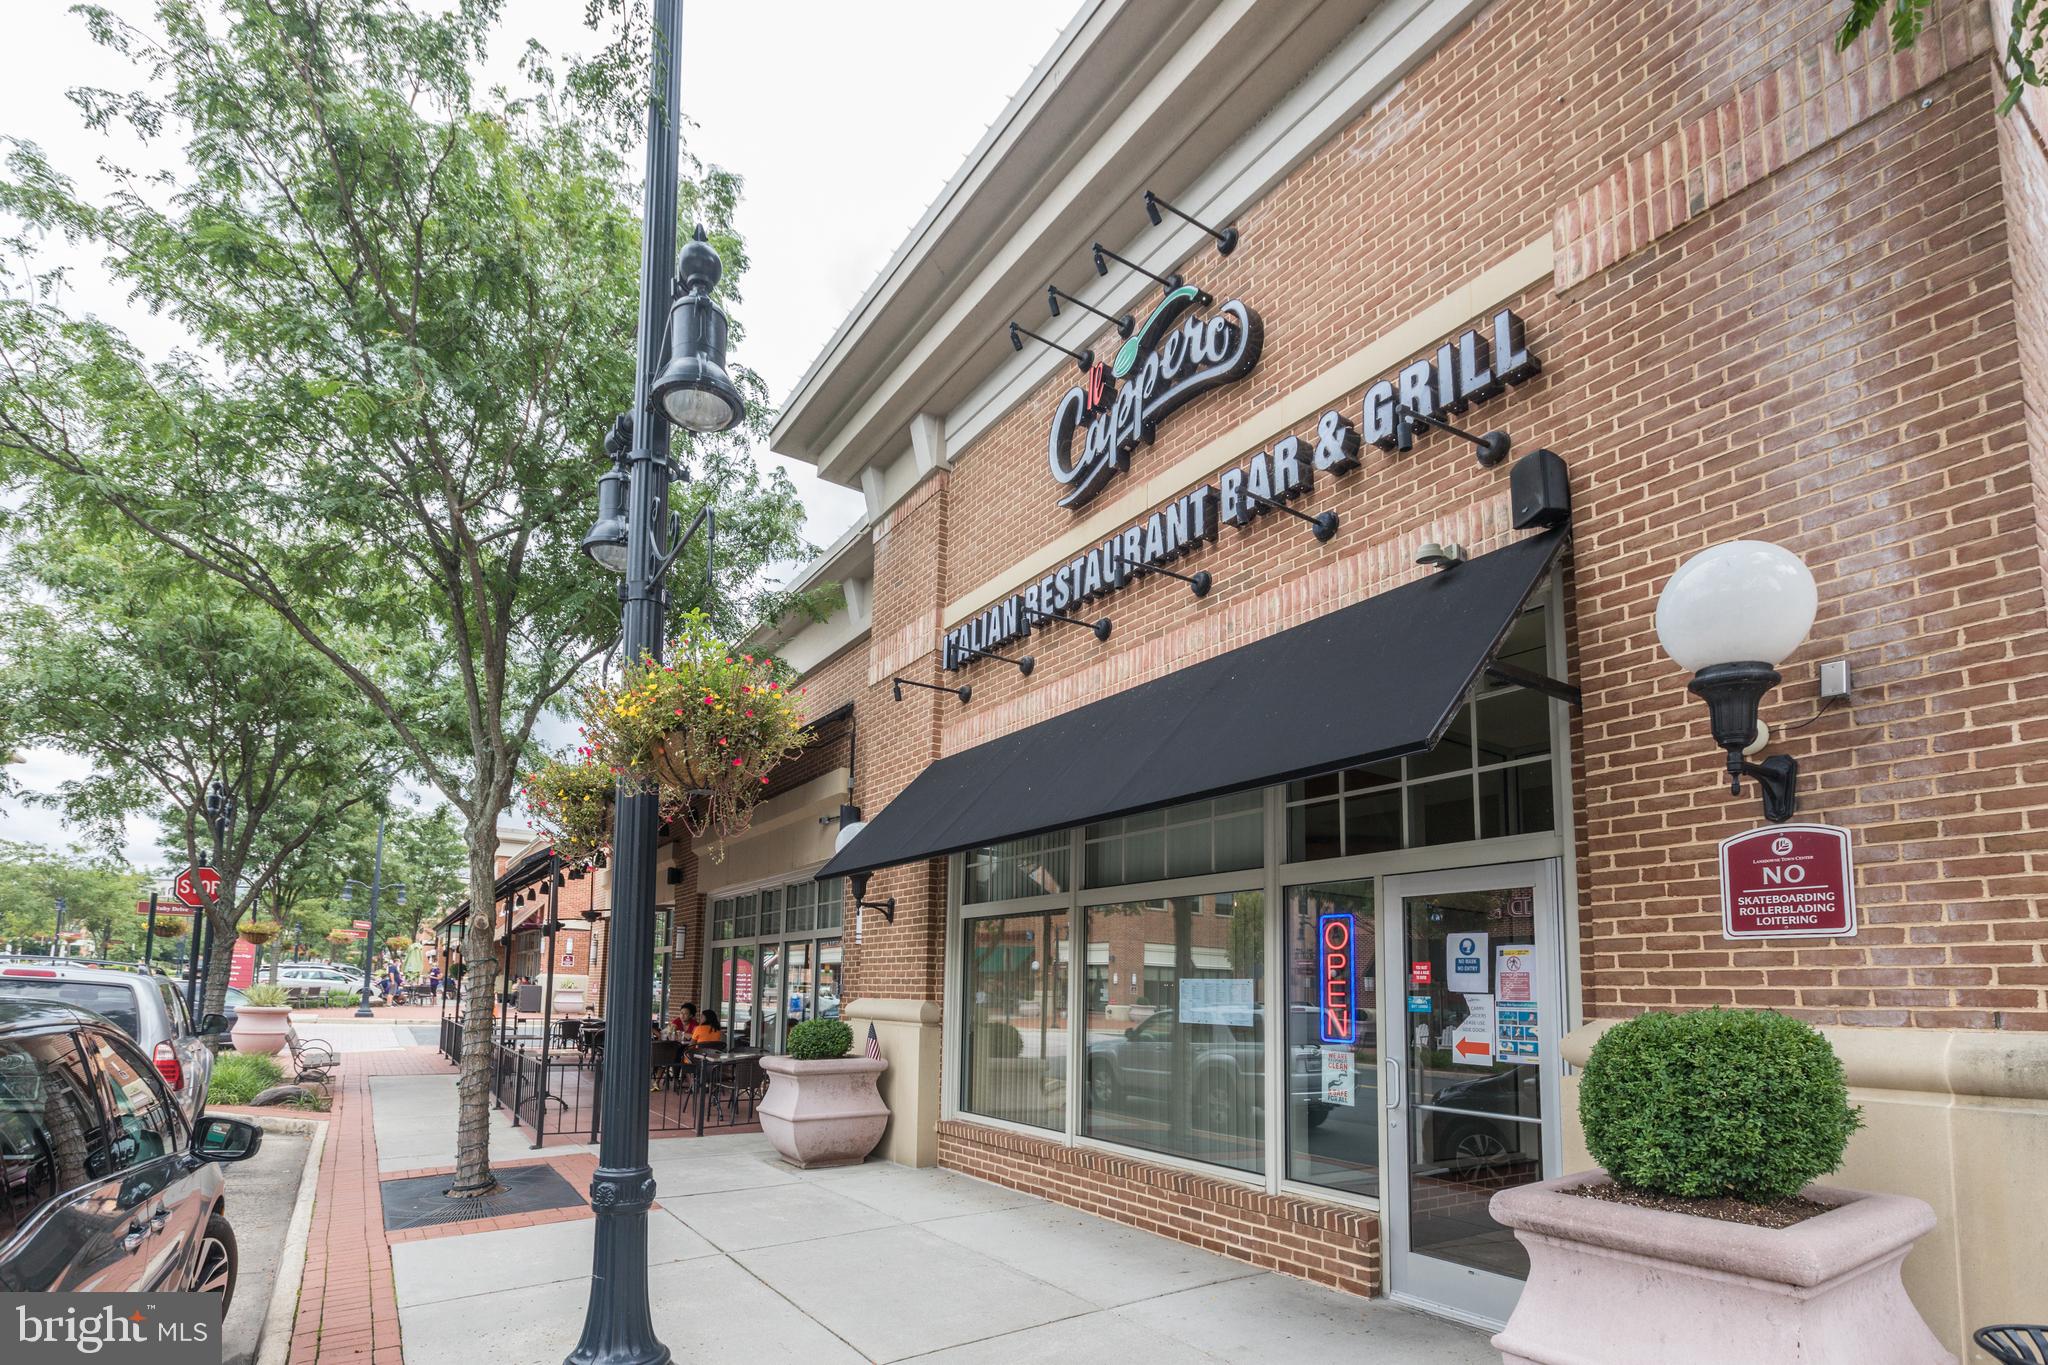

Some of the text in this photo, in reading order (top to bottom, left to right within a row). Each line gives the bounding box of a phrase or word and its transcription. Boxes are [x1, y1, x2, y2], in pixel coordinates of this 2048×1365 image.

[1049, 299, 1262, 507] Cappero
[943, 308, 1538, 672] ITALIAN RESTAURANT BAR & GRILL
[1763, 864, 1805, 885] NO
[180, 880, 220, 894] SOP
[1738, 892, 1835, 906] SKATEBOARDING
[1739, 903, 1835, 916] ROLLERBLADING
[1756, 915, 1818, 926] LOITERING
[1325, 921, 1349, 1037] OPEN
[1328, 1063, 1348, 1071] CLEAN
